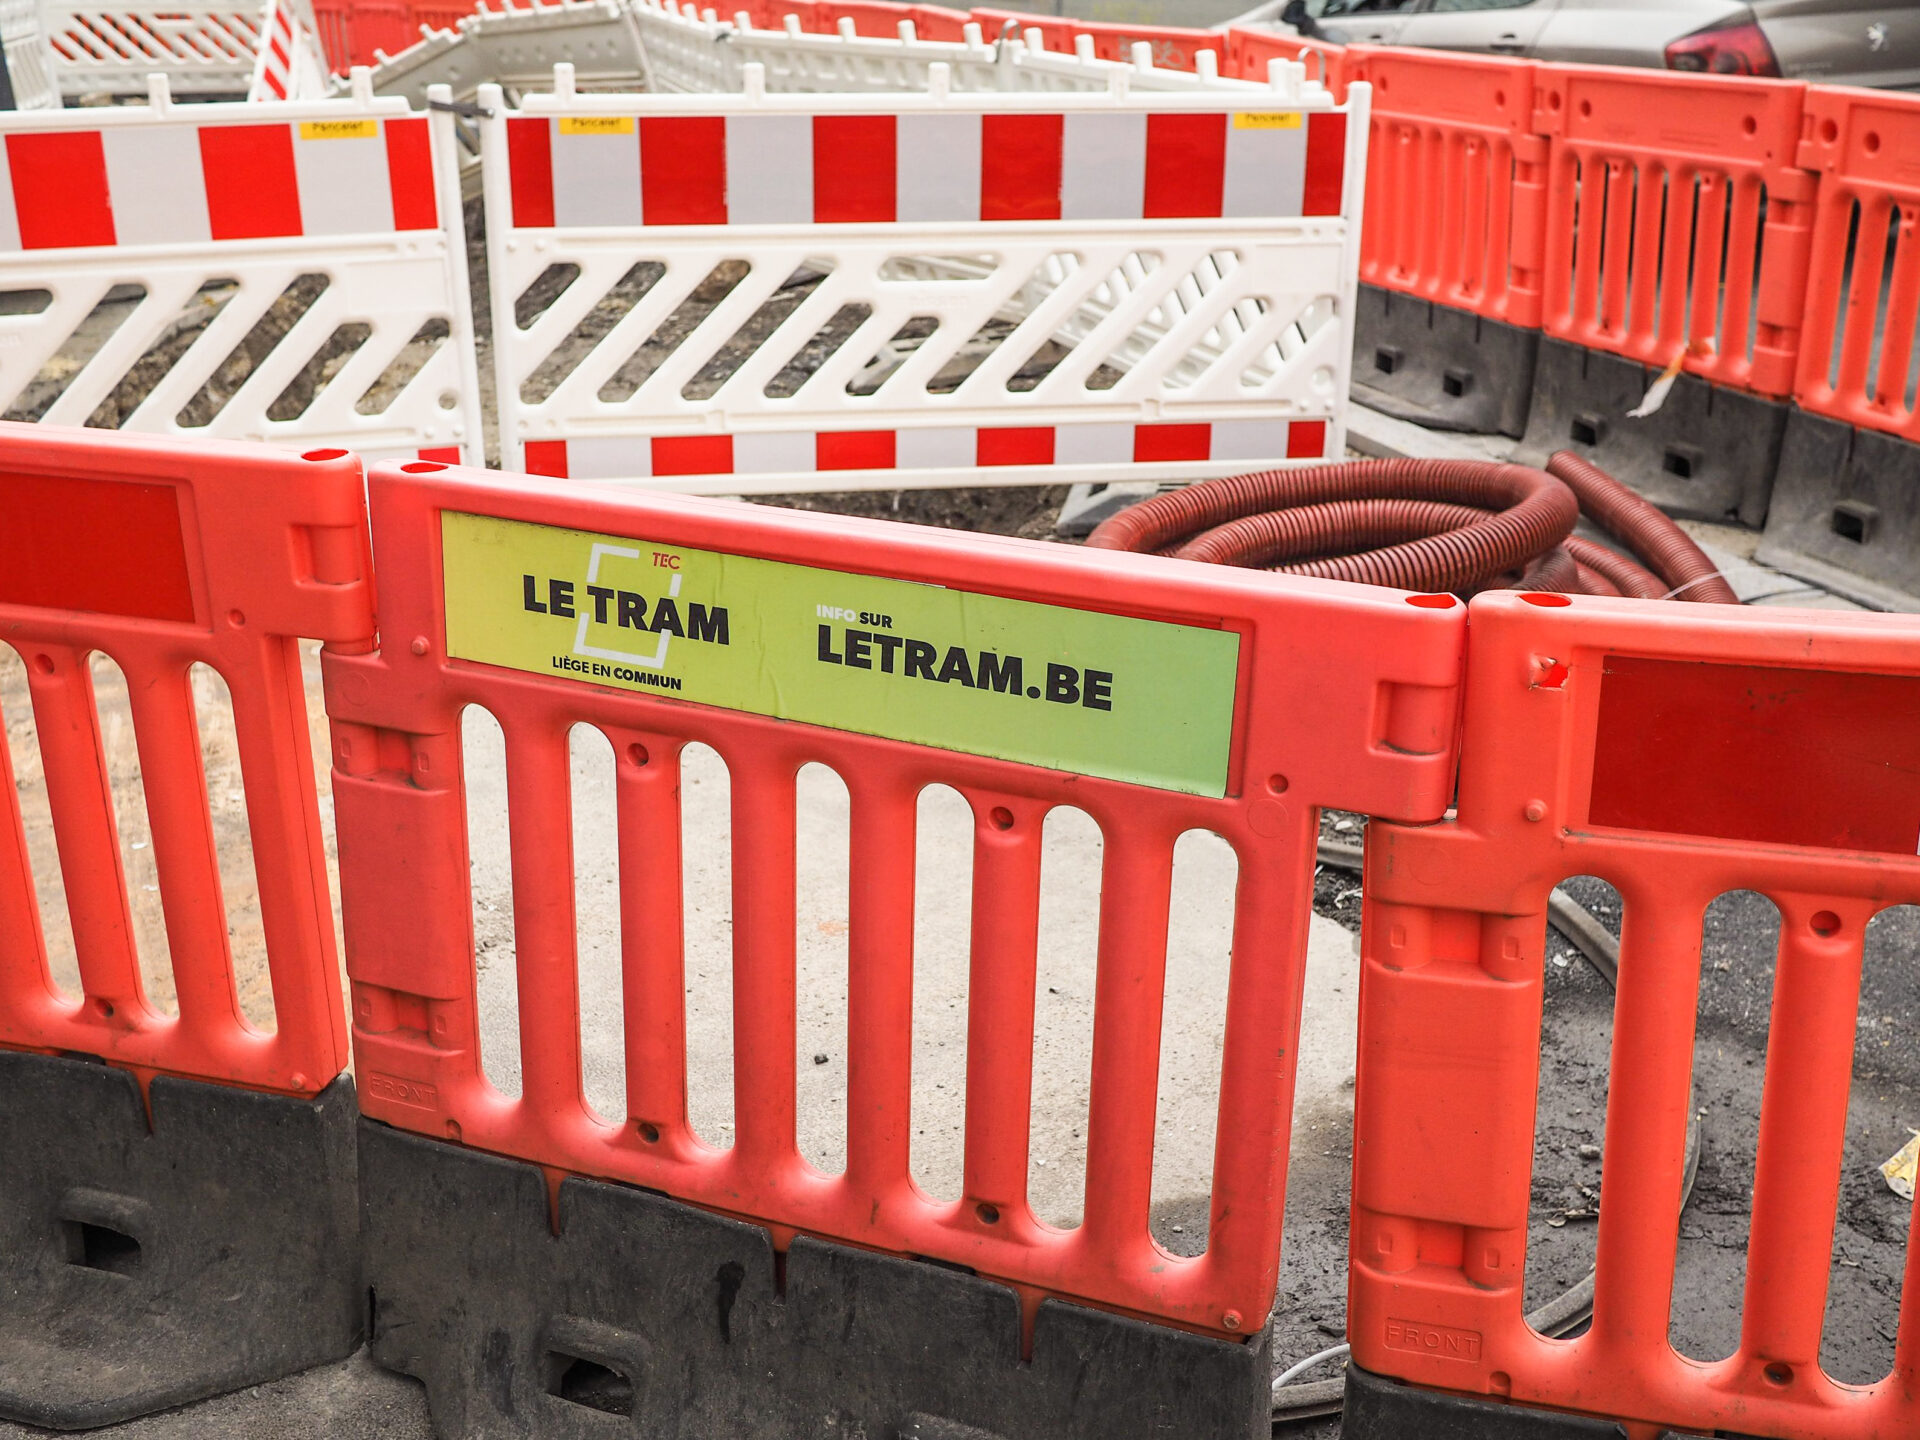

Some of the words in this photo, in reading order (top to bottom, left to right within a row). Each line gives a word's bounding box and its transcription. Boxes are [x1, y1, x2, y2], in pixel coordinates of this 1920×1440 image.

[652, 551, 681, 570] TEC
[523, 574, 576, 619] LE
[586, 584, 730, 646] TRAM
[816, 604, 856, 622] INFO
[859, 611, 892, 629] SUR
[552, 655, 589, 674] LIÈGE
[592, 662, 611, 678] EN
[613, 667, 682, 691] COMMUN
[817, 624, 1113, 712] LETRAM.BE
[370, 1076, 436, 1103] FRONT
[1386, 1325, 1479, 1354] FRONT
